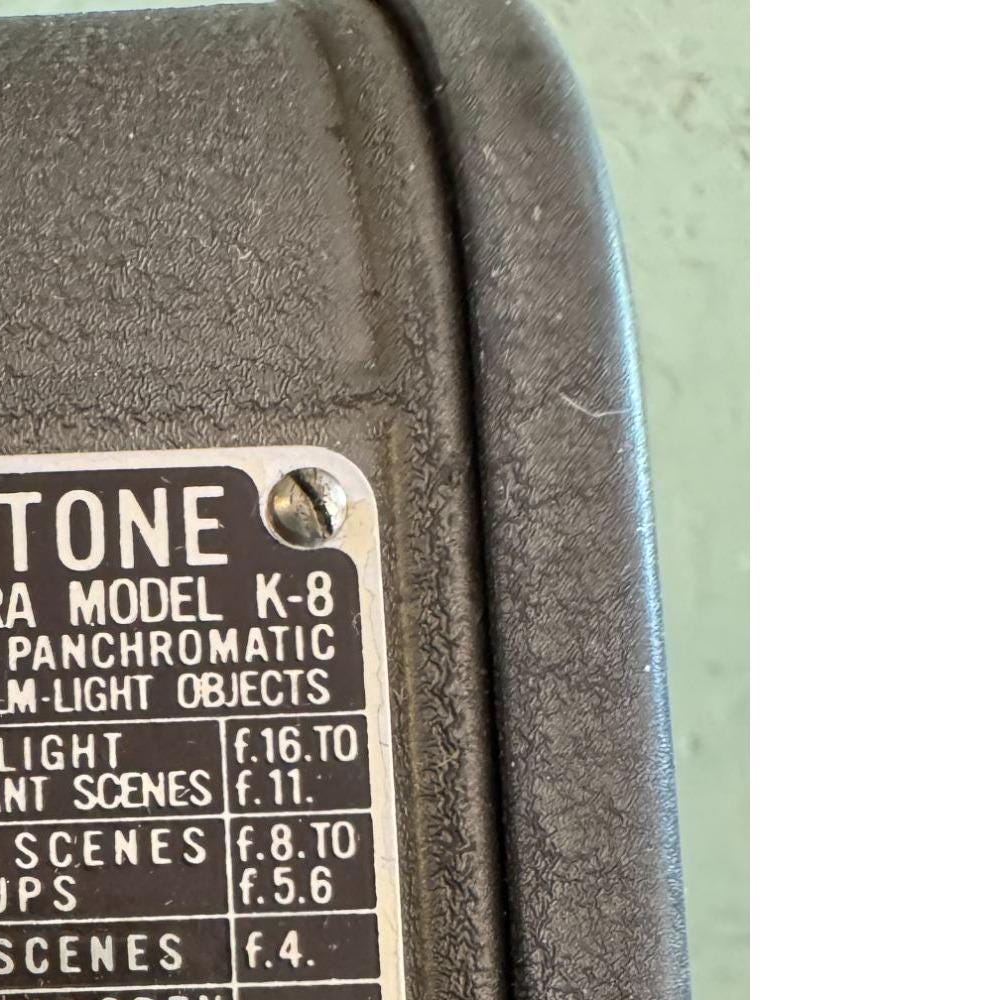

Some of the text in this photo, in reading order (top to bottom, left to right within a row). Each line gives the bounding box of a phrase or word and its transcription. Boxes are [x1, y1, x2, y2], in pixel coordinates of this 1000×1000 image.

[69, 576, 223, 626] MODEL
[256, 571, 334, 619] K-8
[8, 624, 335, 671] PANCHROMATIC
[177, 668, 330, 708] OBJECTS
[73, 769, 212, 813] SCENES
[15, 827, 206, 869] SCENES
[239, 865, 332, 905] f.5.6
